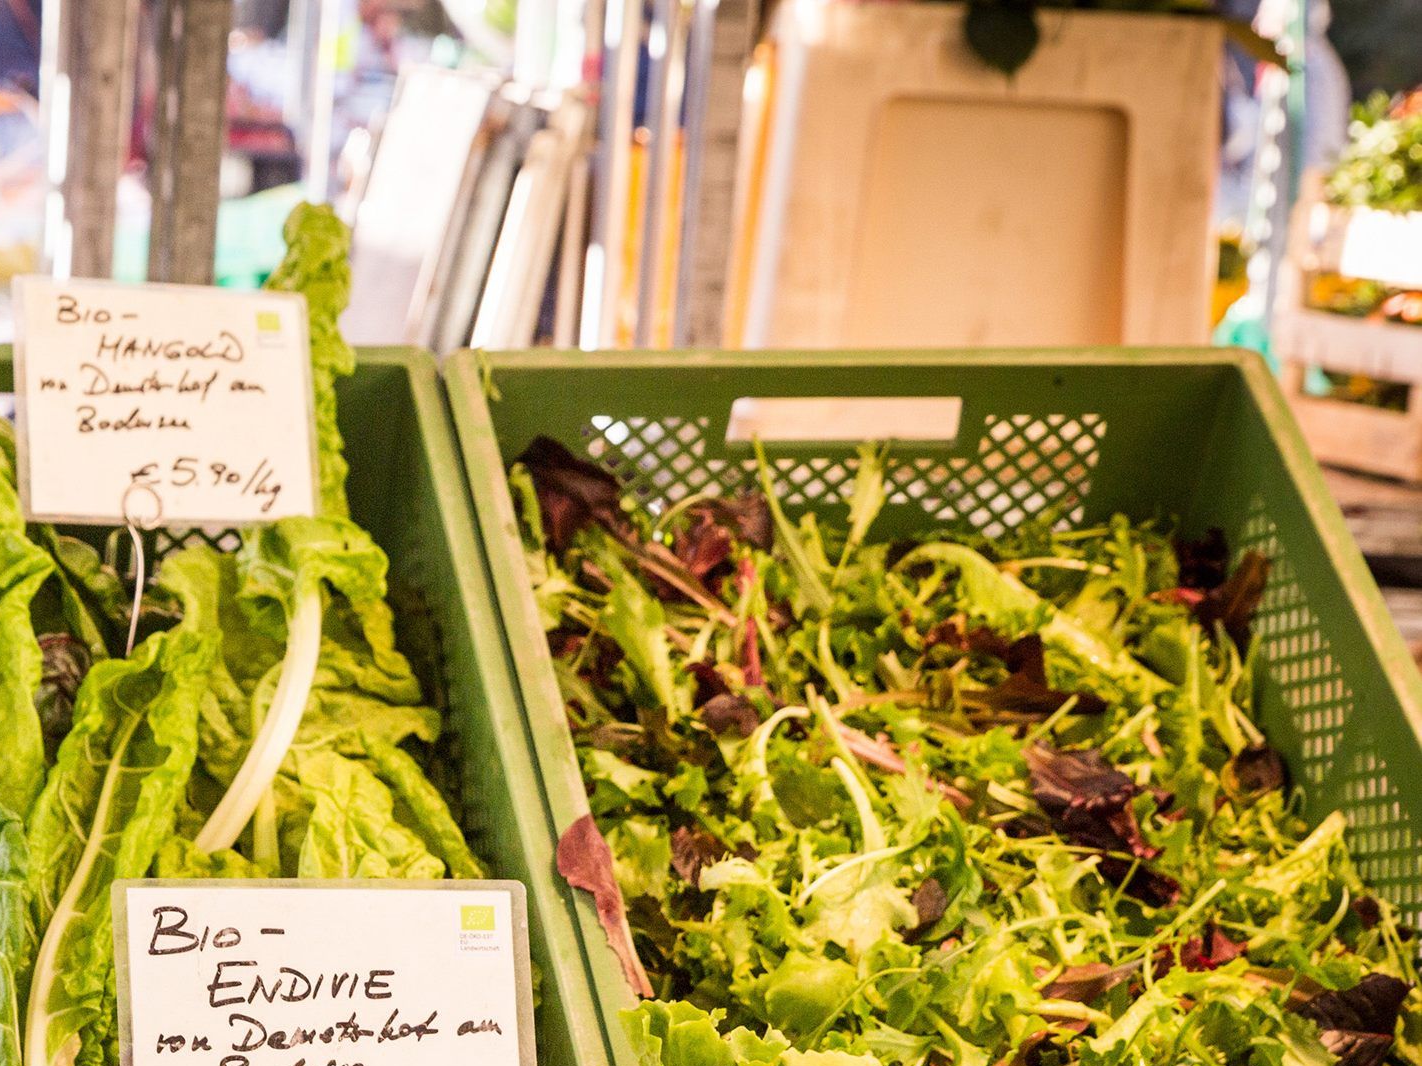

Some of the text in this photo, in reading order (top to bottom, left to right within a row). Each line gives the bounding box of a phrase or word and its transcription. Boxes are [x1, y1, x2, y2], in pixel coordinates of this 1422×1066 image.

[97, 331, 244, 362] MANGOLD
[207, 960, 396, 1008] ENDIVIE
[457, 1018, 504, 1036] am
